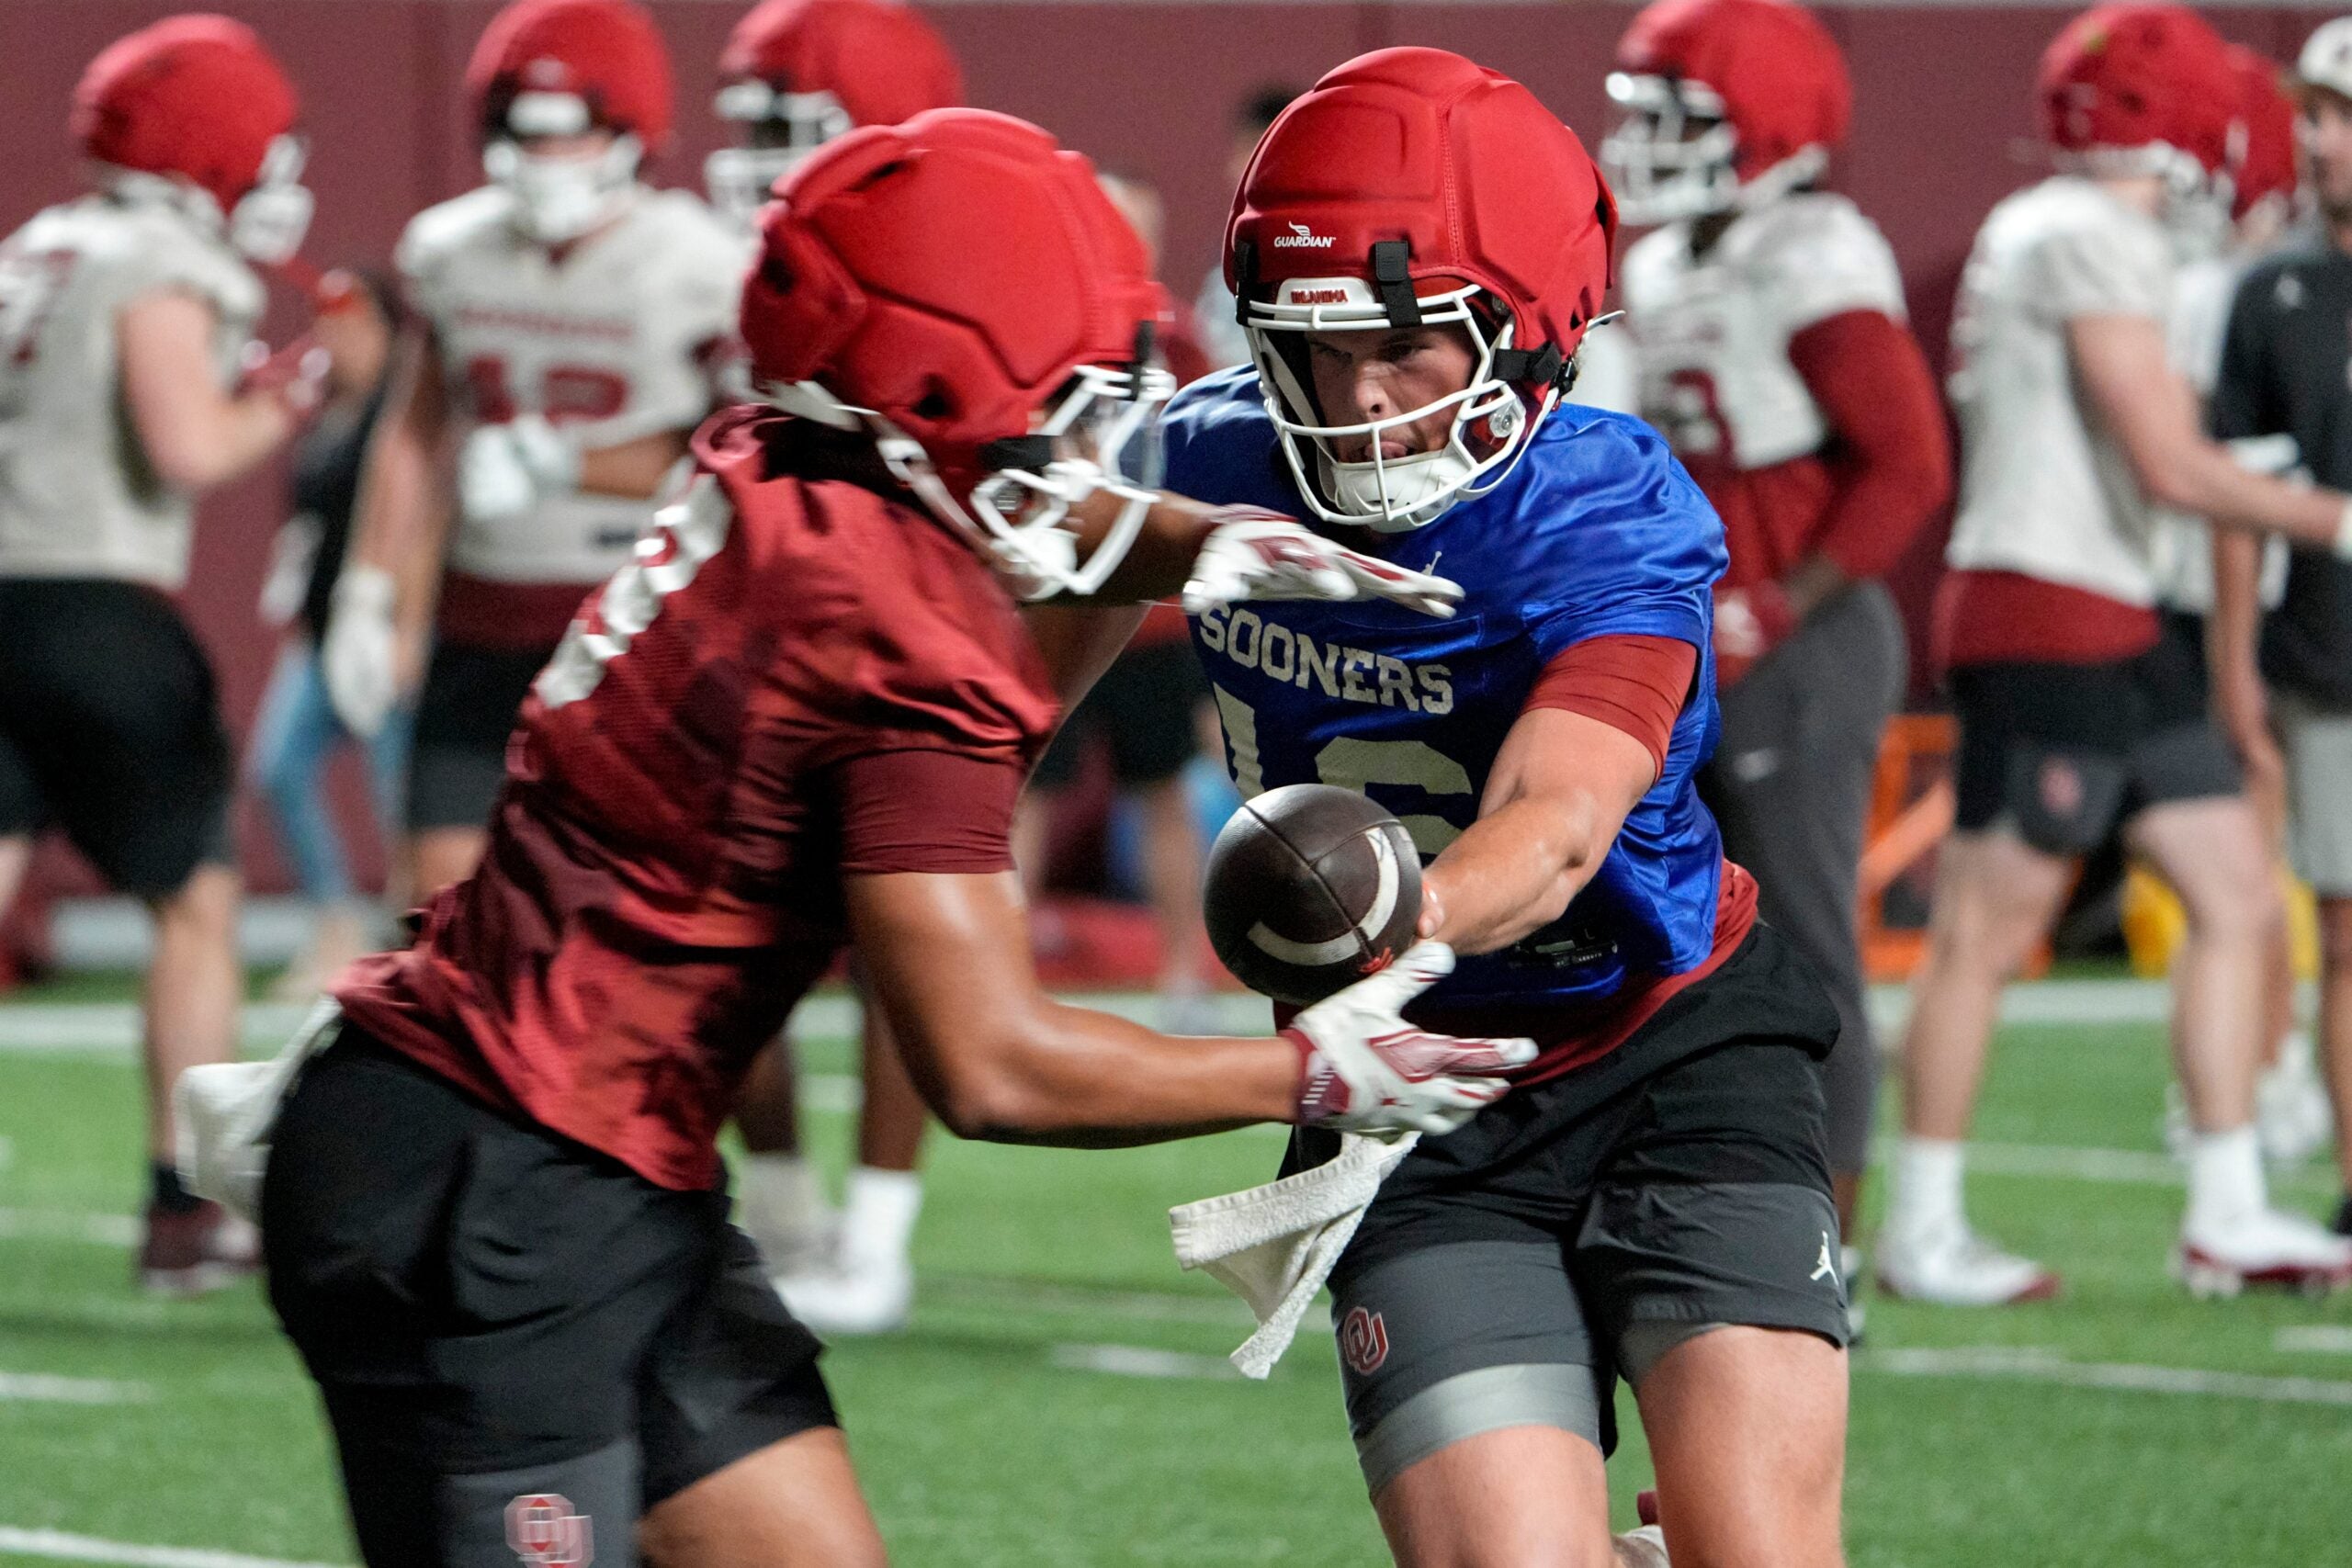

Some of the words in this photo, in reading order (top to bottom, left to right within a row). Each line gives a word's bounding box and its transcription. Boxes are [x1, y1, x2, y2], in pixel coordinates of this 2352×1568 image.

[1273, 235, 1333, 249] GUARDIAN
[1198, 602, 1454, 716] SOONERS
[1342, 1305, 1389, 1376] OU
[503, 1493, 595, 1568] OU
